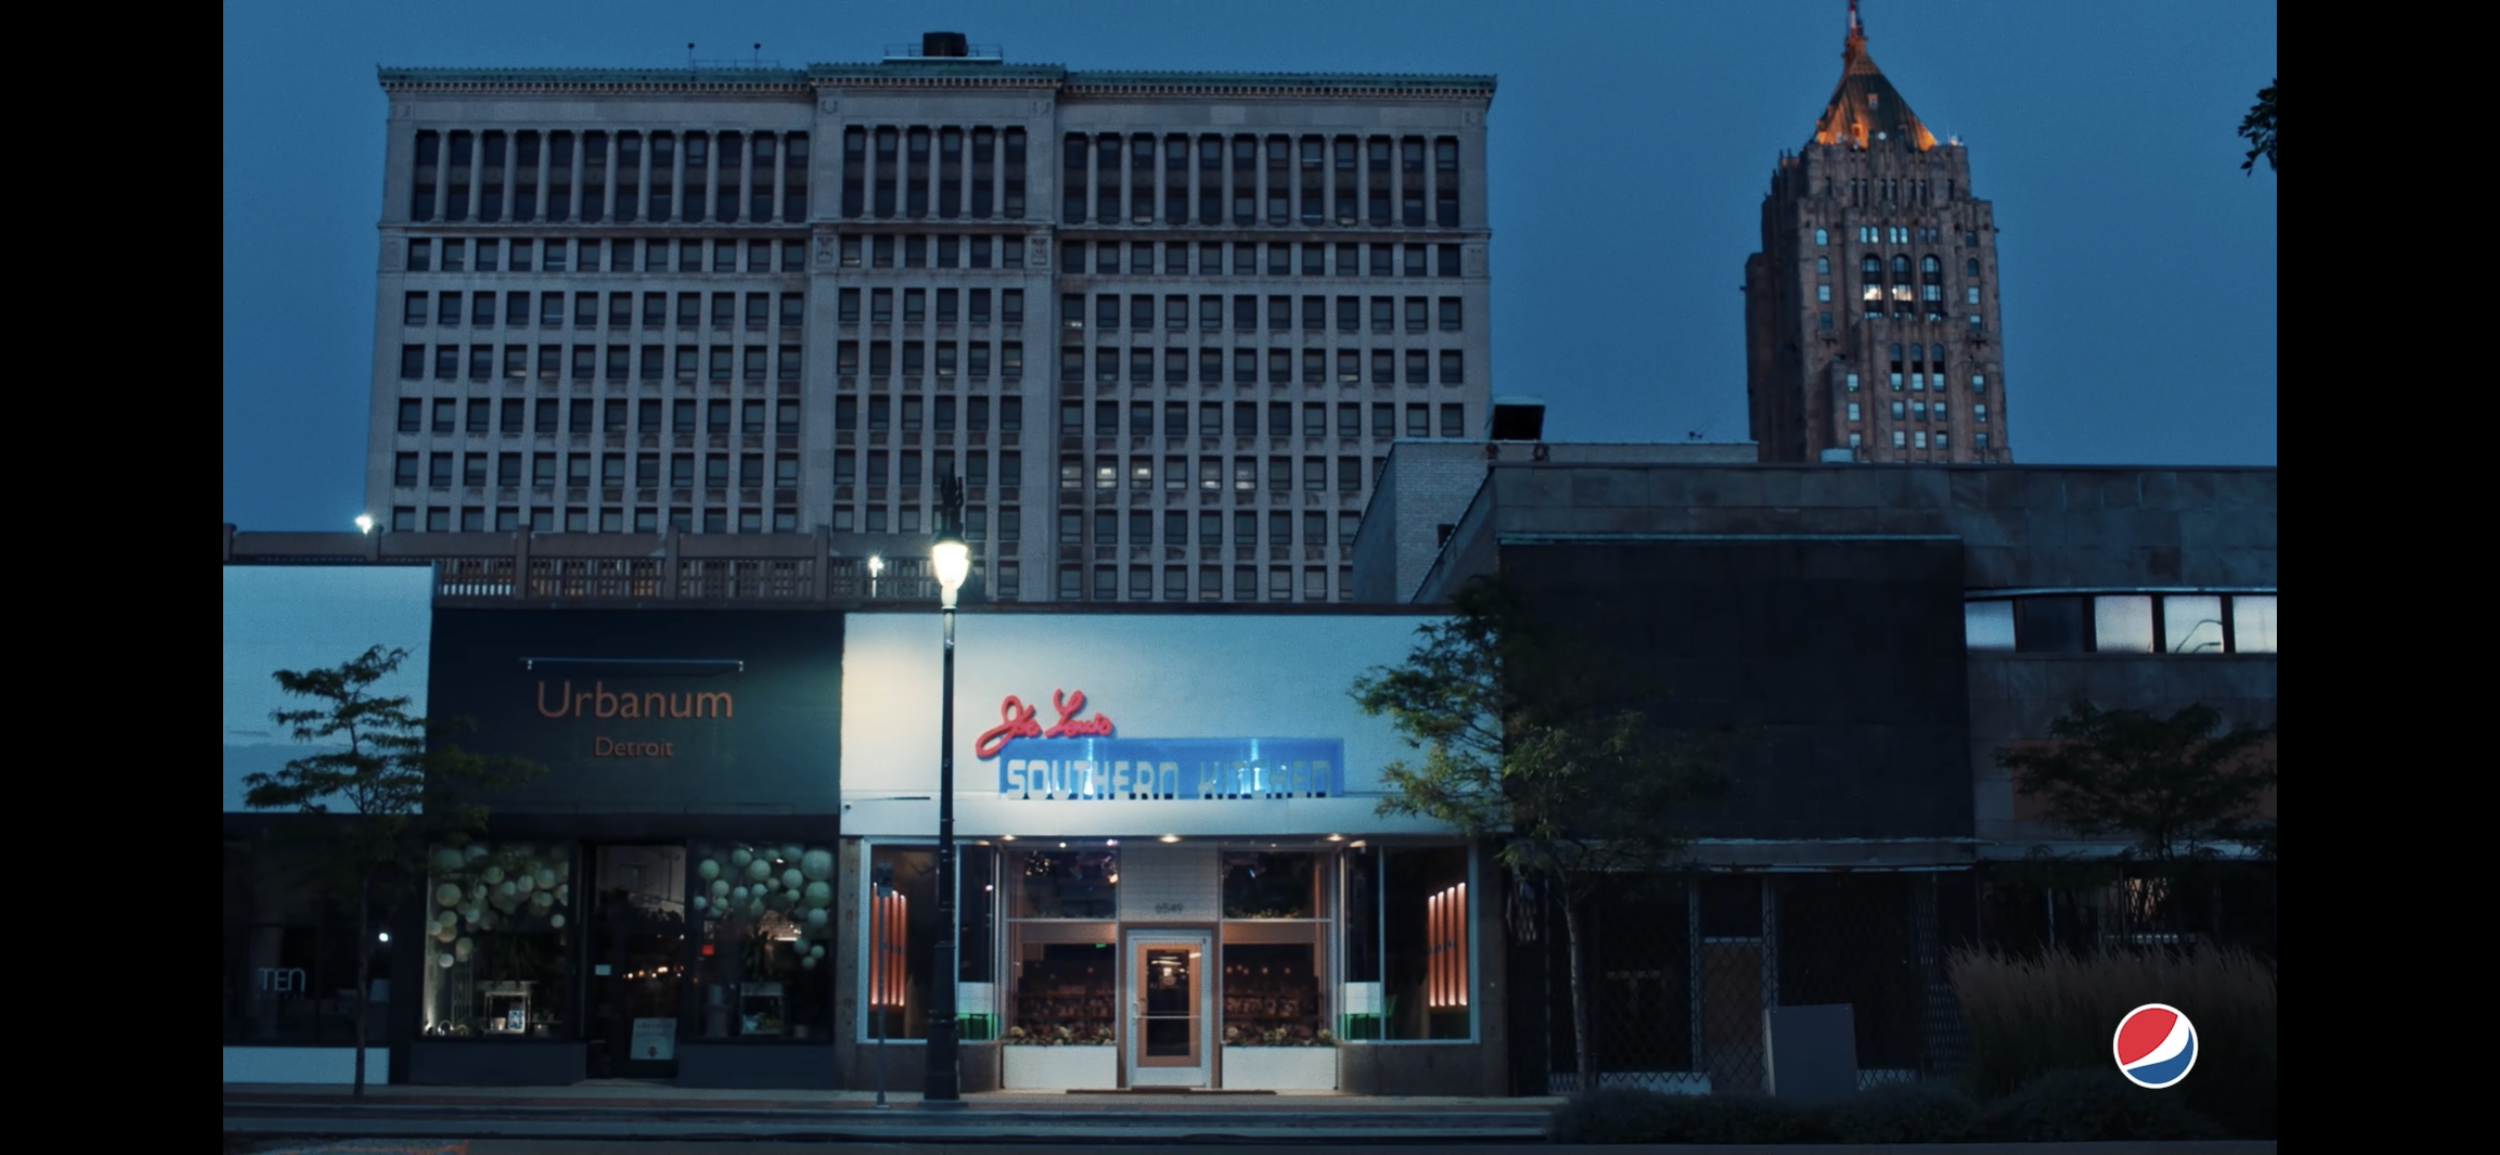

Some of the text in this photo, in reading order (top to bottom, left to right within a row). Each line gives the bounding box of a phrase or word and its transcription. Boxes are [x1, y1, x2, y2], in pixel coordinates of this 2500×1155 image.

[537, 681, 734, 719] Urbanum
[1044, 688, 1113, 738] Louis
[594, 736, 674, 757] Detroit
[1007, 760, 1331, 800] SOUTHERN KITCHEN
